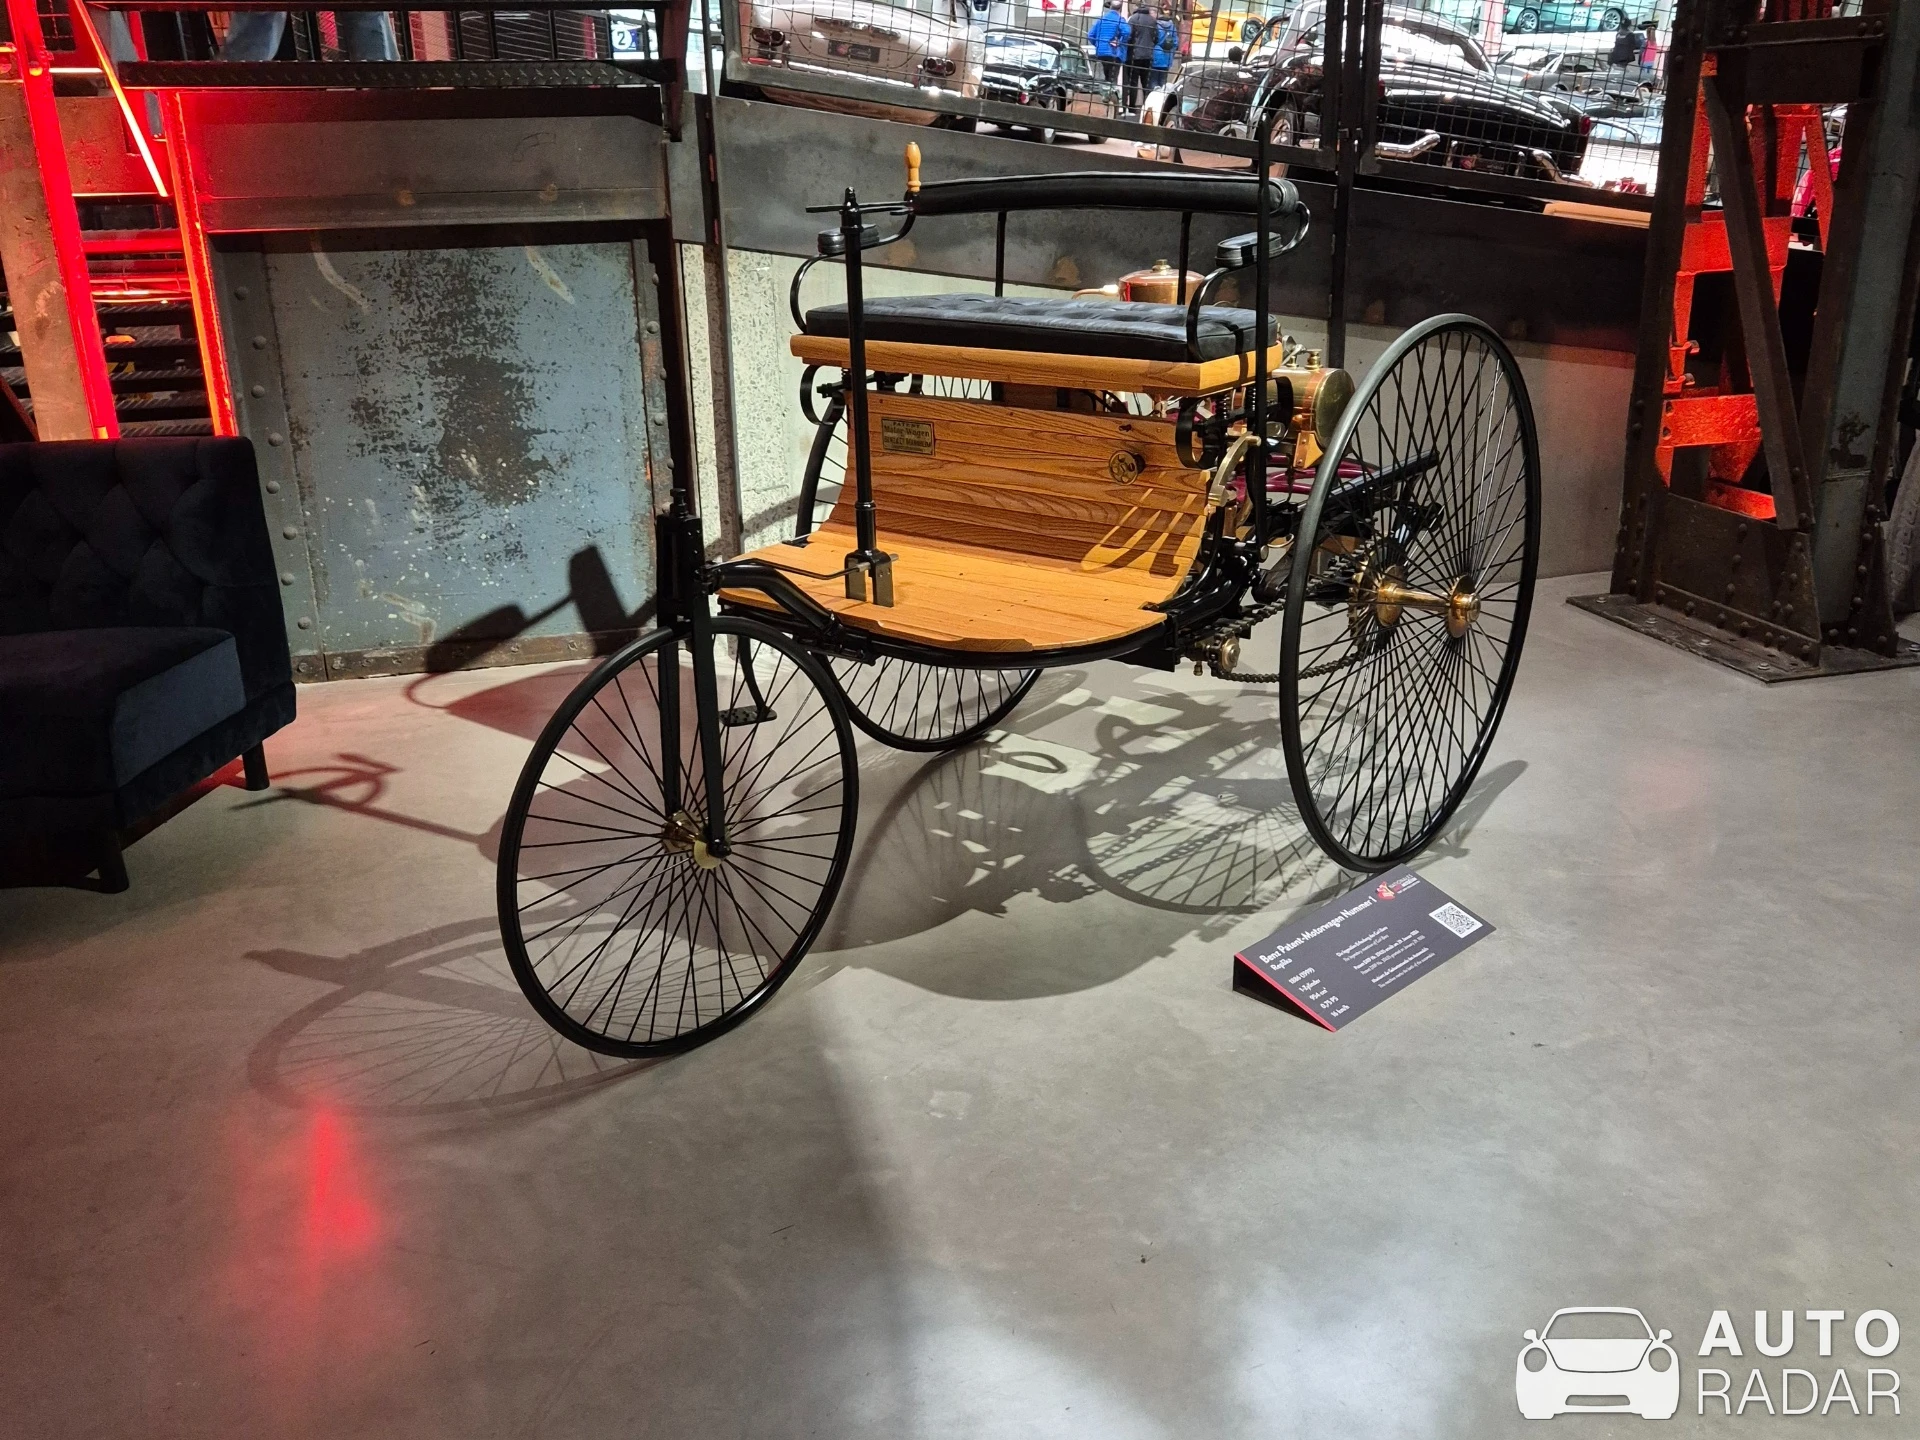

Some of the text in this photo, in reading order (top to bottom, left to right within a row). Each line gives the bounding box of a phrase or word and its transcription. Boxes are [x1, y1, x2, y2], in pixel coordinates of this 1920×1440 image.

[617, 31, 625, 45] 2
[1259, 951, 1281, 963] Benz
[1277, 916, 1345, 953] Patent-Motorwagen
[1340, 900, 1372, 918] Nummer
[1270, 958, 1292, 970] Replika
